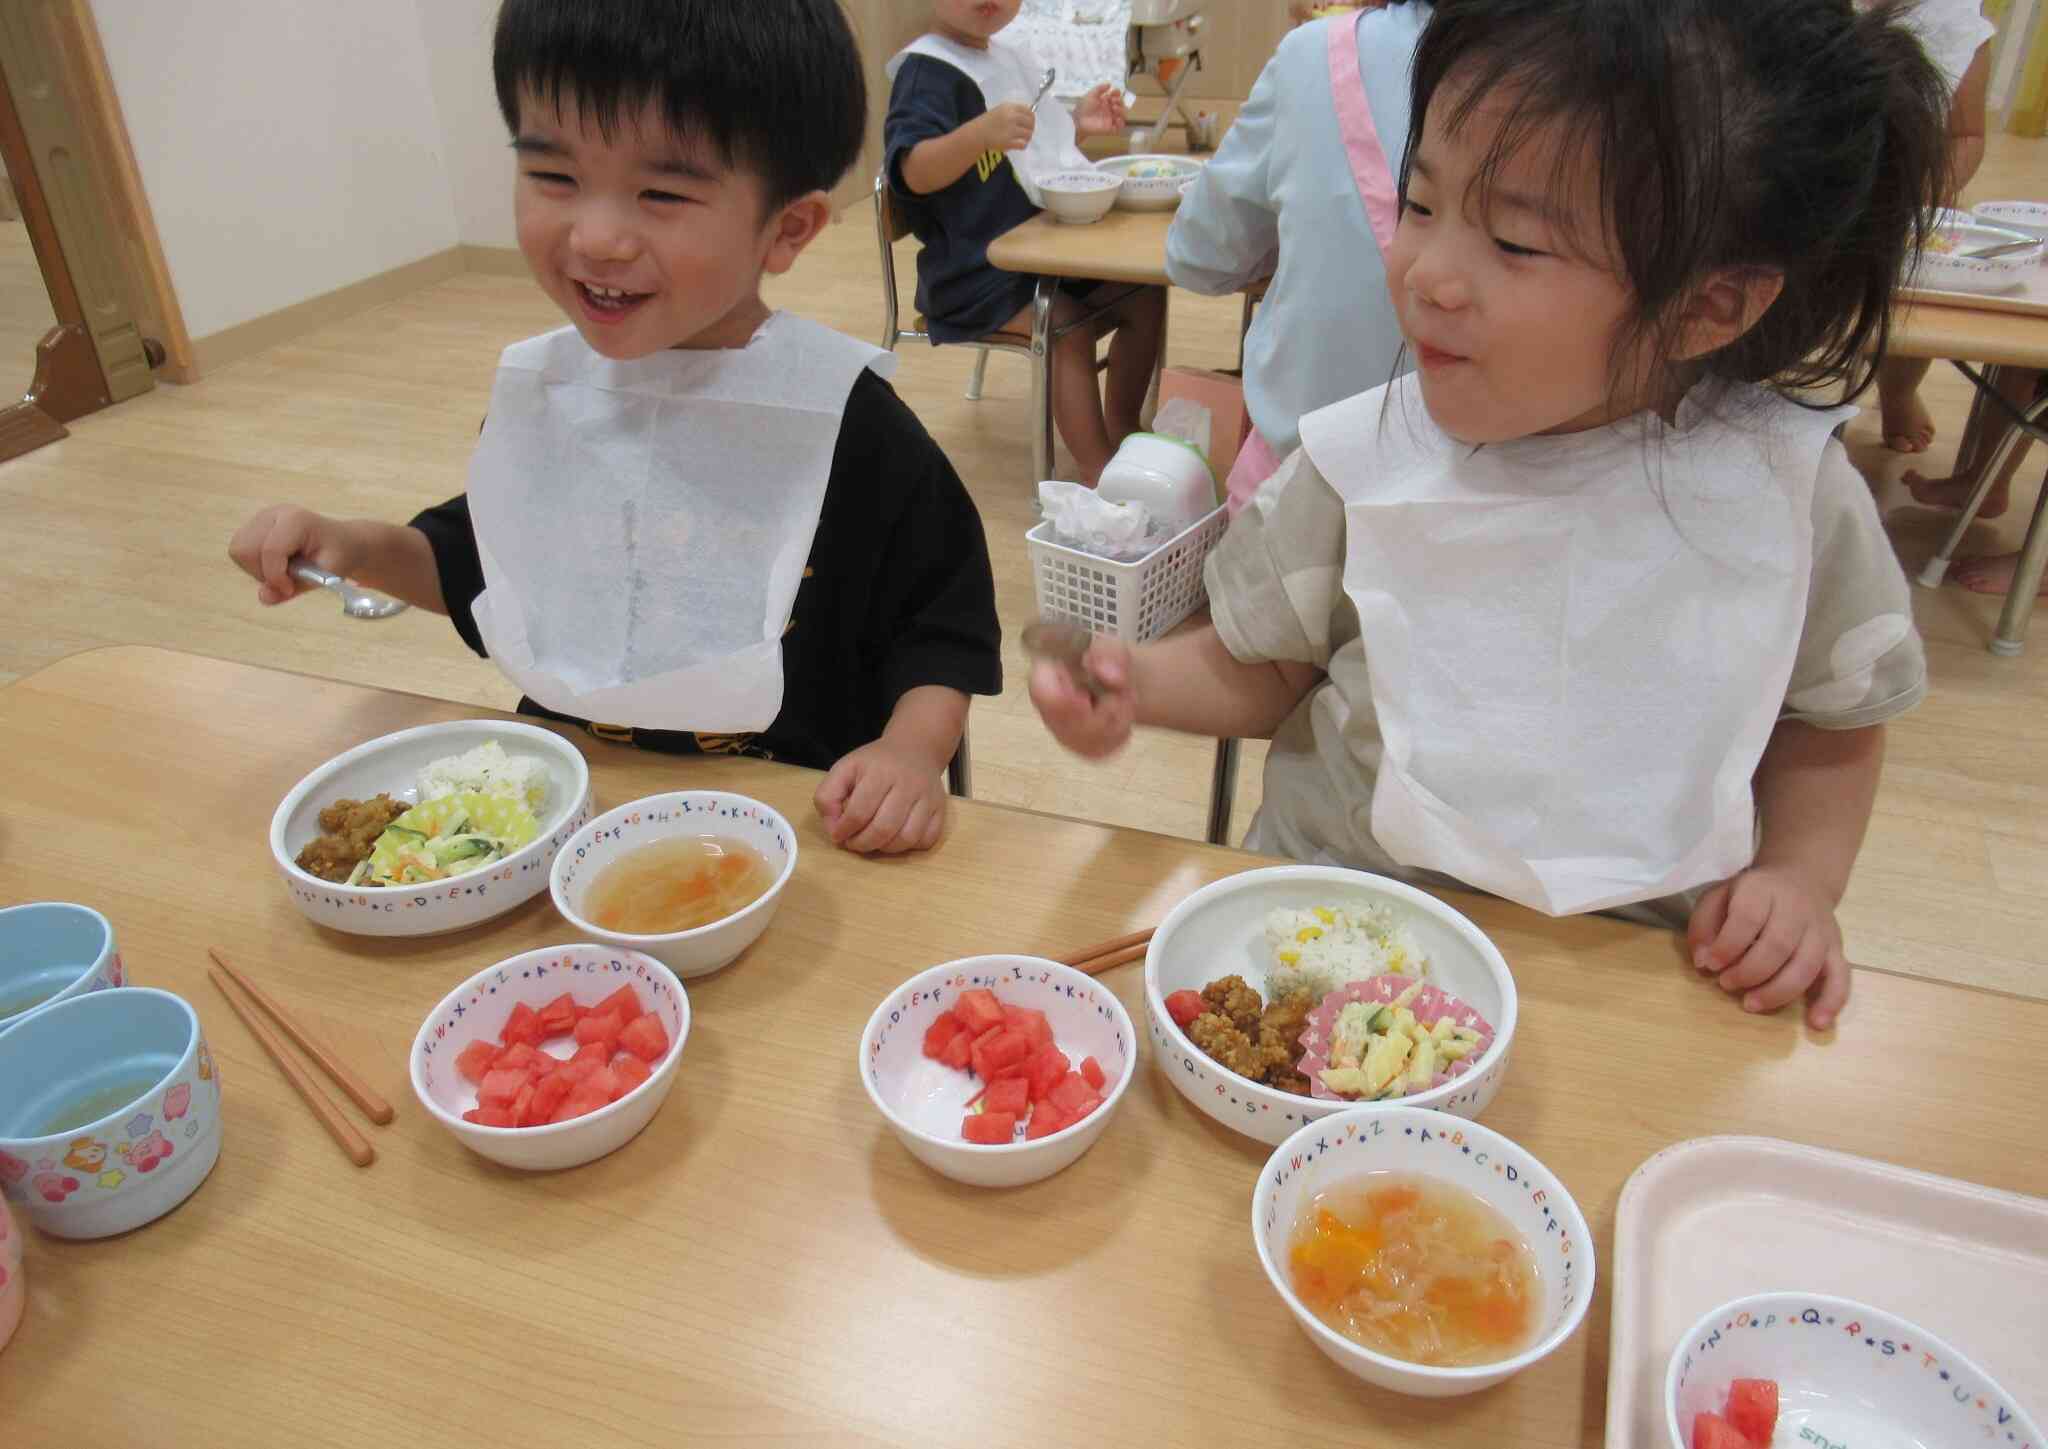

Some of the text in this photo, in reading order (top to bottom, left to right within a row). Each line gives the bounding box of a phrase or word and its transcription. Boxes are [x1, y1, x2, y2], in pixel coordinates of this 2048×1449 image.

[1316, 1136, 1328, 1154] X
[1420, 1129, 1432, 1143] A
[1507, 1165, 1518, 1181] D
[1532, 1190, 1546, 1205] E
[1802, 1308, 1821, 1324] Q
[1845, 1321, 1861, 1336] R
[1881, 1340, 1895, 1355] S
